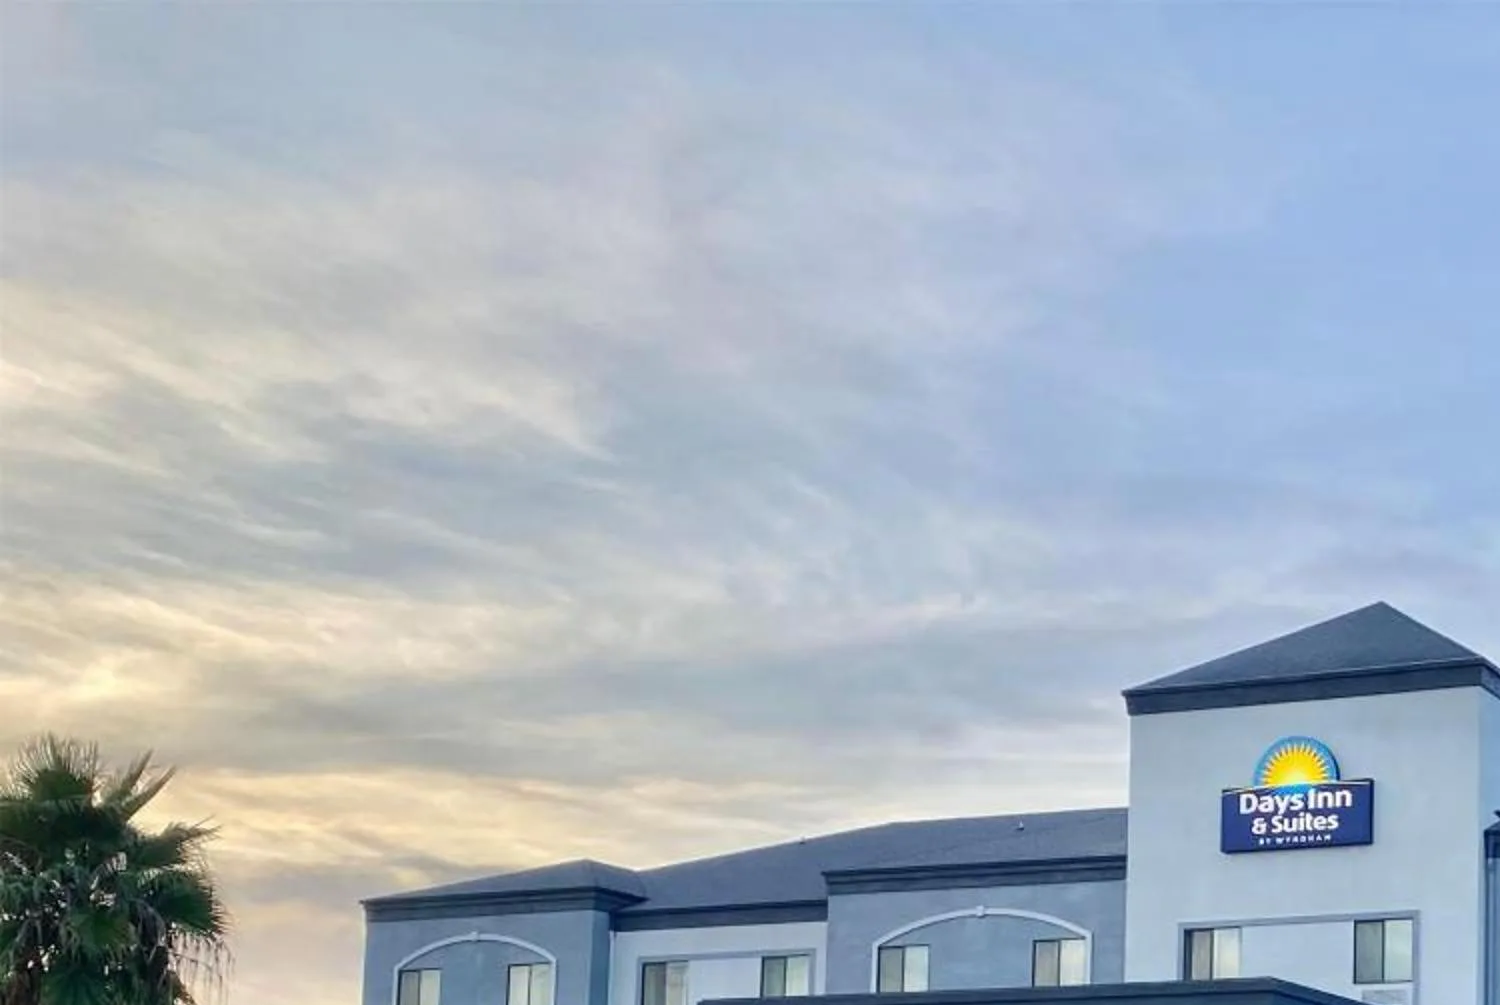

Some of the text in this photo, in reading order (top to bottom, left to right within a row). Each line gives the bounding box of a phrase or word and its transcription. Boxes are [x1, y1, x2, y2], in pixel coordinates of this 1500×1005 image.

[1239, 788, 1352, 815] Days Inn
[1251, 812, 1339, 834] & Suites
